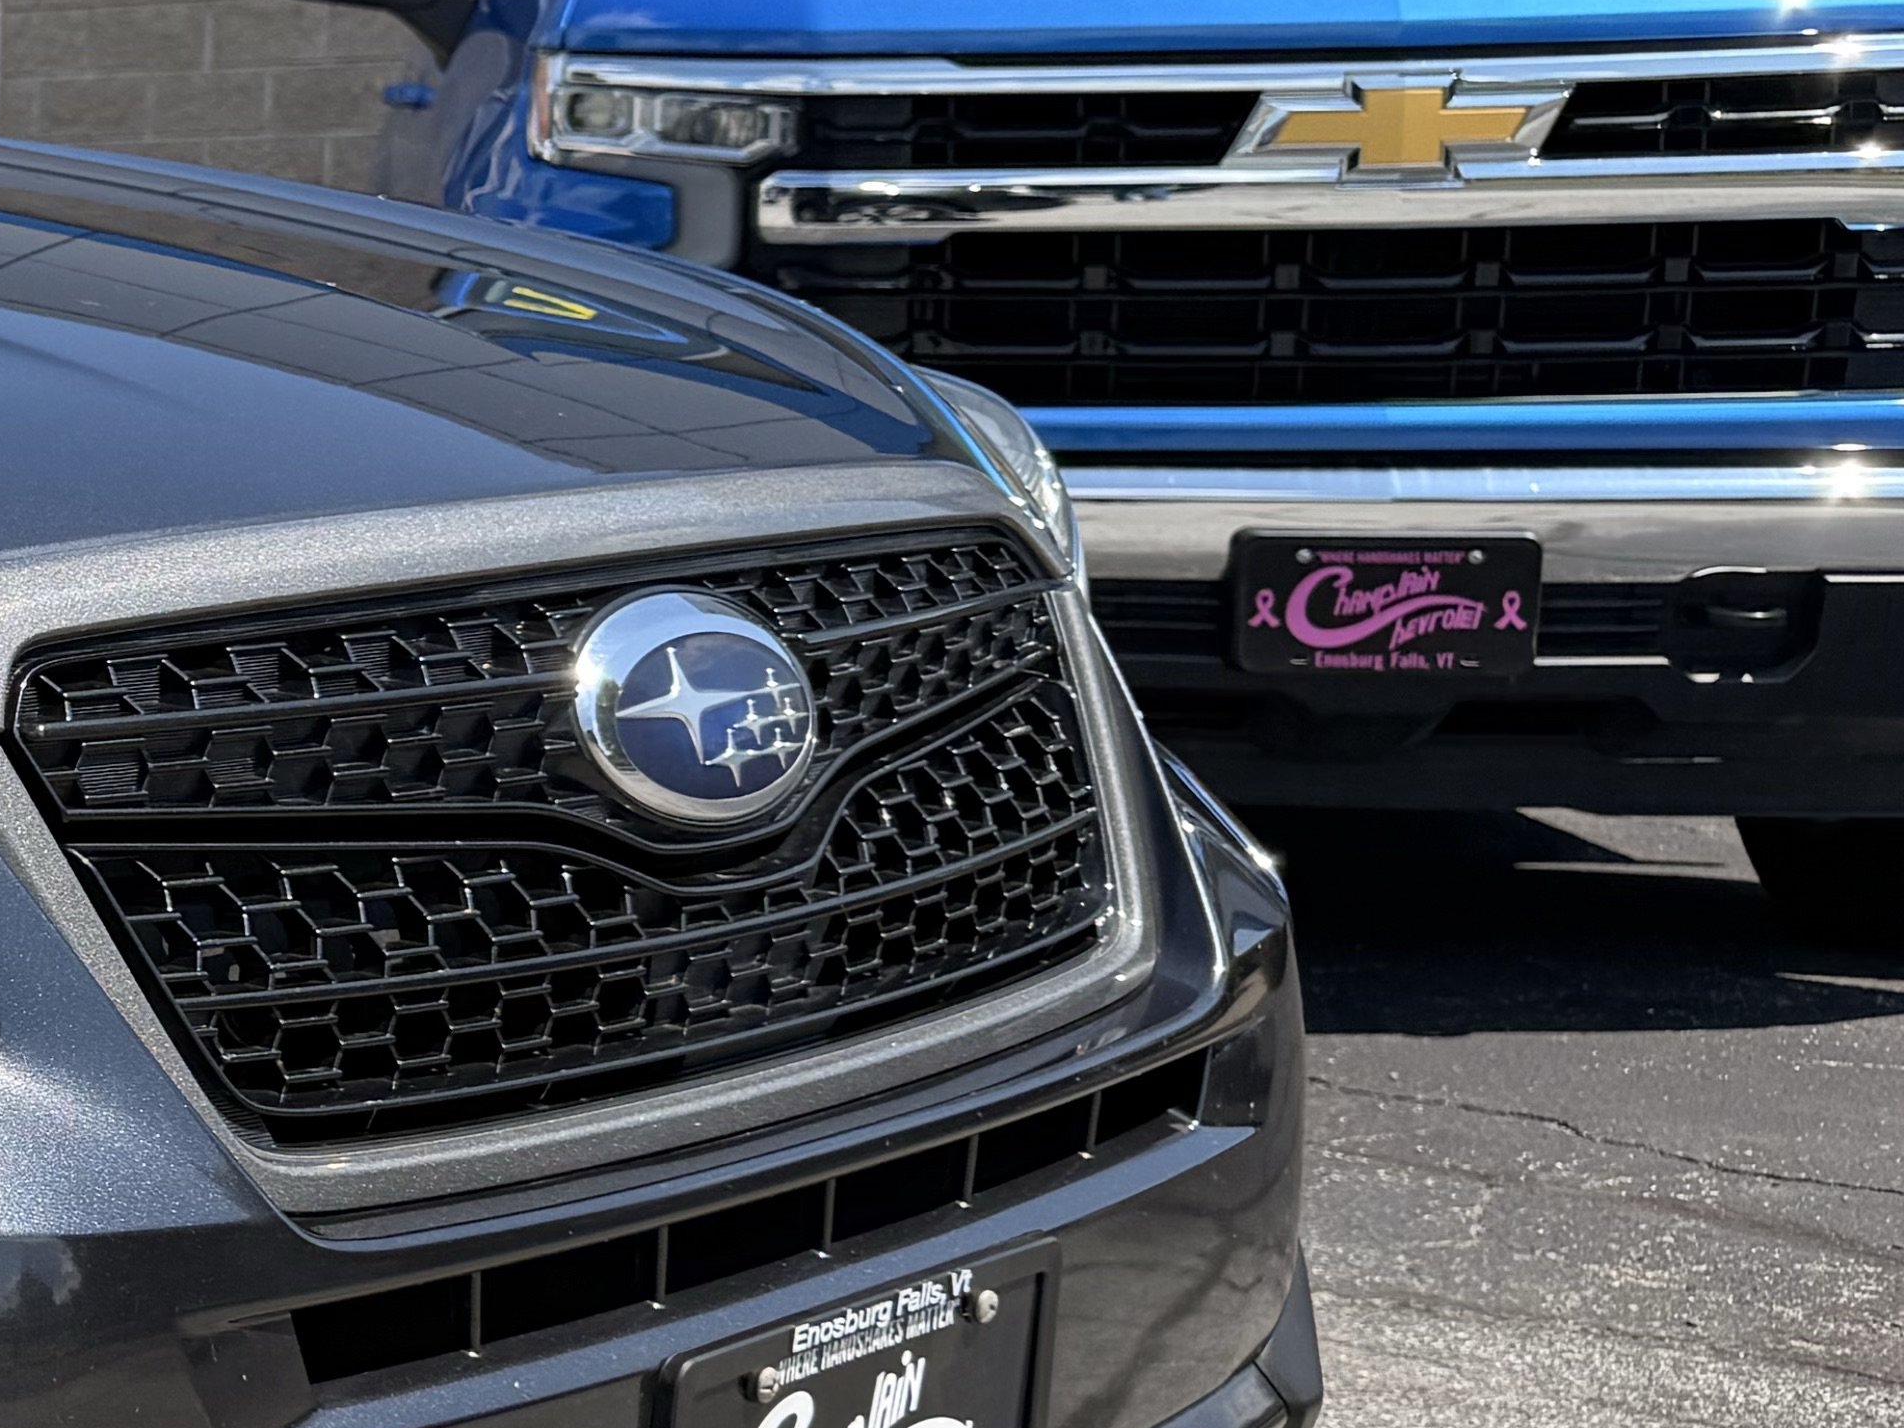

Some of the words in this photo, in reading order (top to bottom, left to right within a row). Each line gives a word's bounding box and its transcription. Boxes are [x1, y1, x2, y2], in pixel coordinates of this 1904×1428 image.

[792, 1299, 893, 1353] Enosburg
[896, 1281, 947, 1317] Falls,
[951, 1269, 973, 1297] Vt
